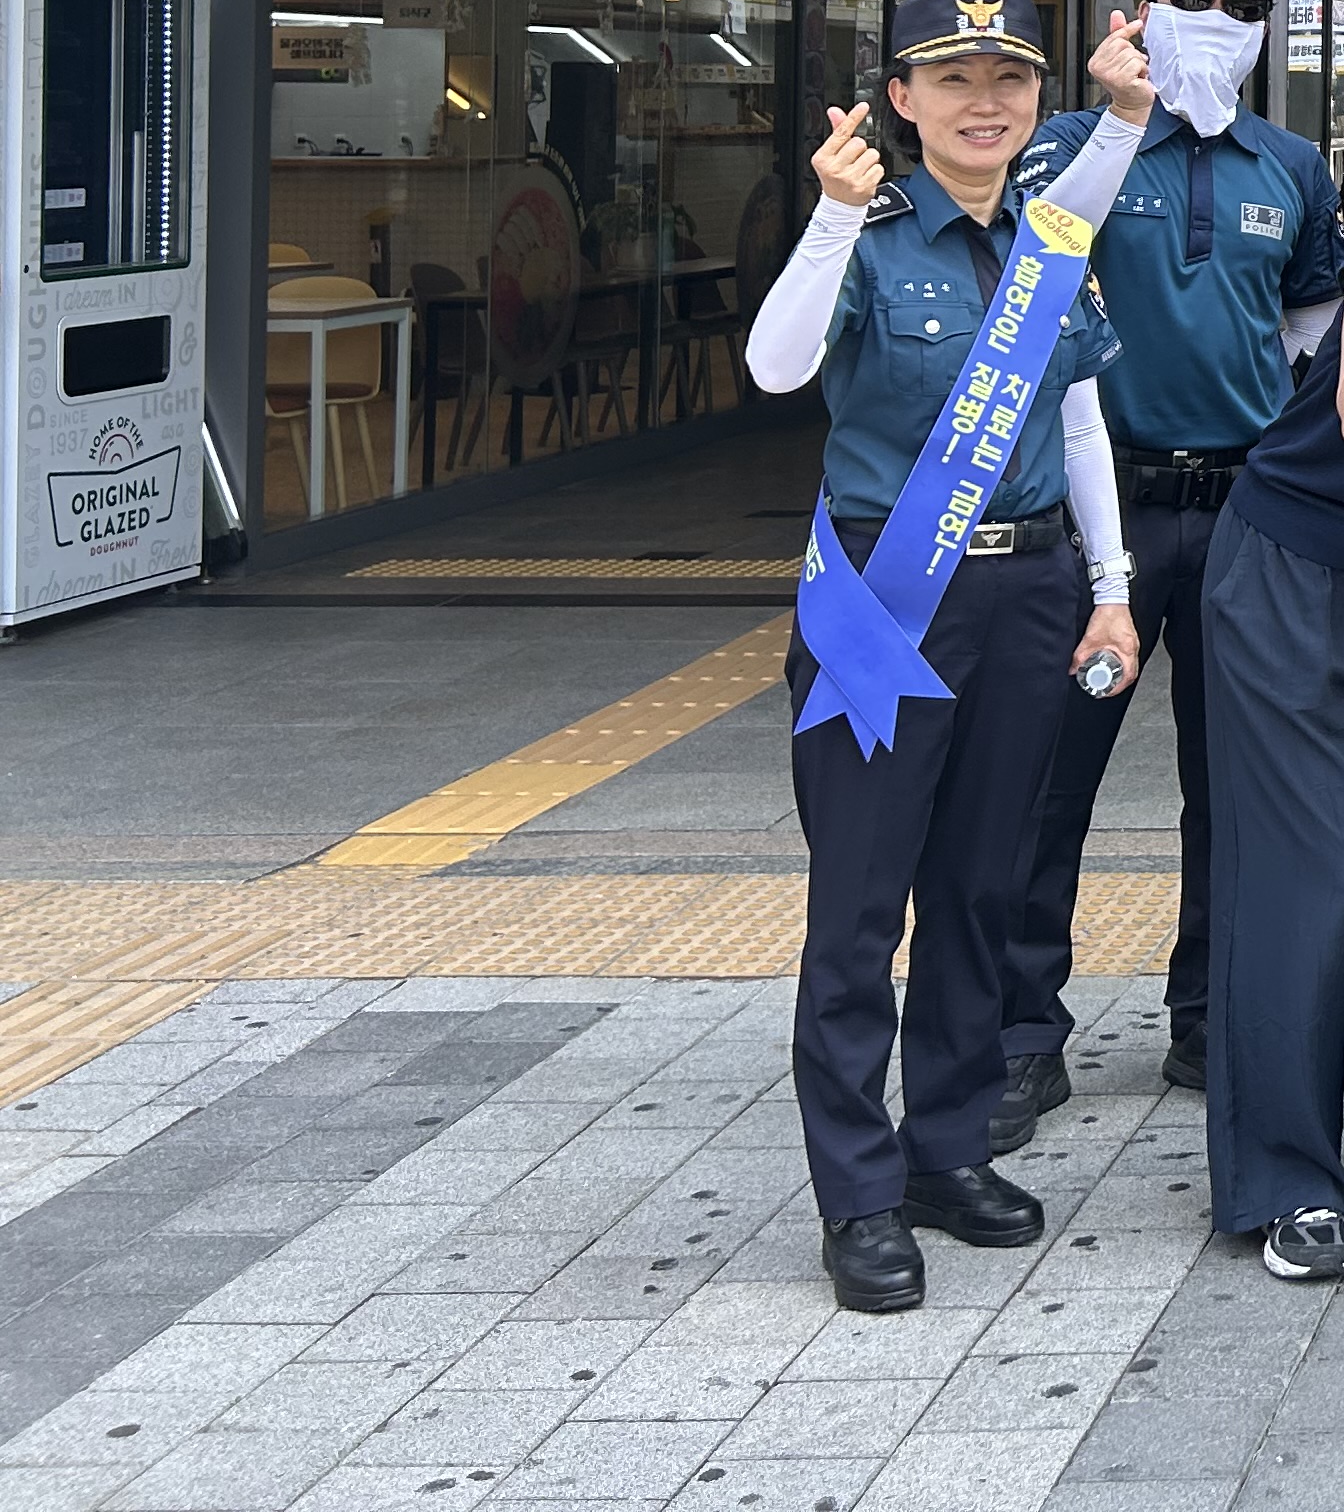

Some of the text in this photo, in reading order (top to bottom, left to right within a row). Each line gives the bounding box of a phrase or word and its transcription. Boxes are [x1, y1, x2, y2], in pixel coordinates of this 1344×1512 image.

[1039, 202, 1074, 228] NO
[1245, 204, 1282, 226] 경찰
[941, 255, 1044, 464] 흡연은 질병!
[50, 409, 88, 429] SINCE
[141, 387, 199, 419] LIGHT
[50, 428, 89, 456] 1937
[88, 415, 144, 460] HOME OF THE
[926, 373, 1031, 576] 치료는 금연!
[71, 476, 160, 515] ORIGINAL
[80, 507, 151, 543] GLAZED
[90, 536, 140, 557] DOUGHNUT
